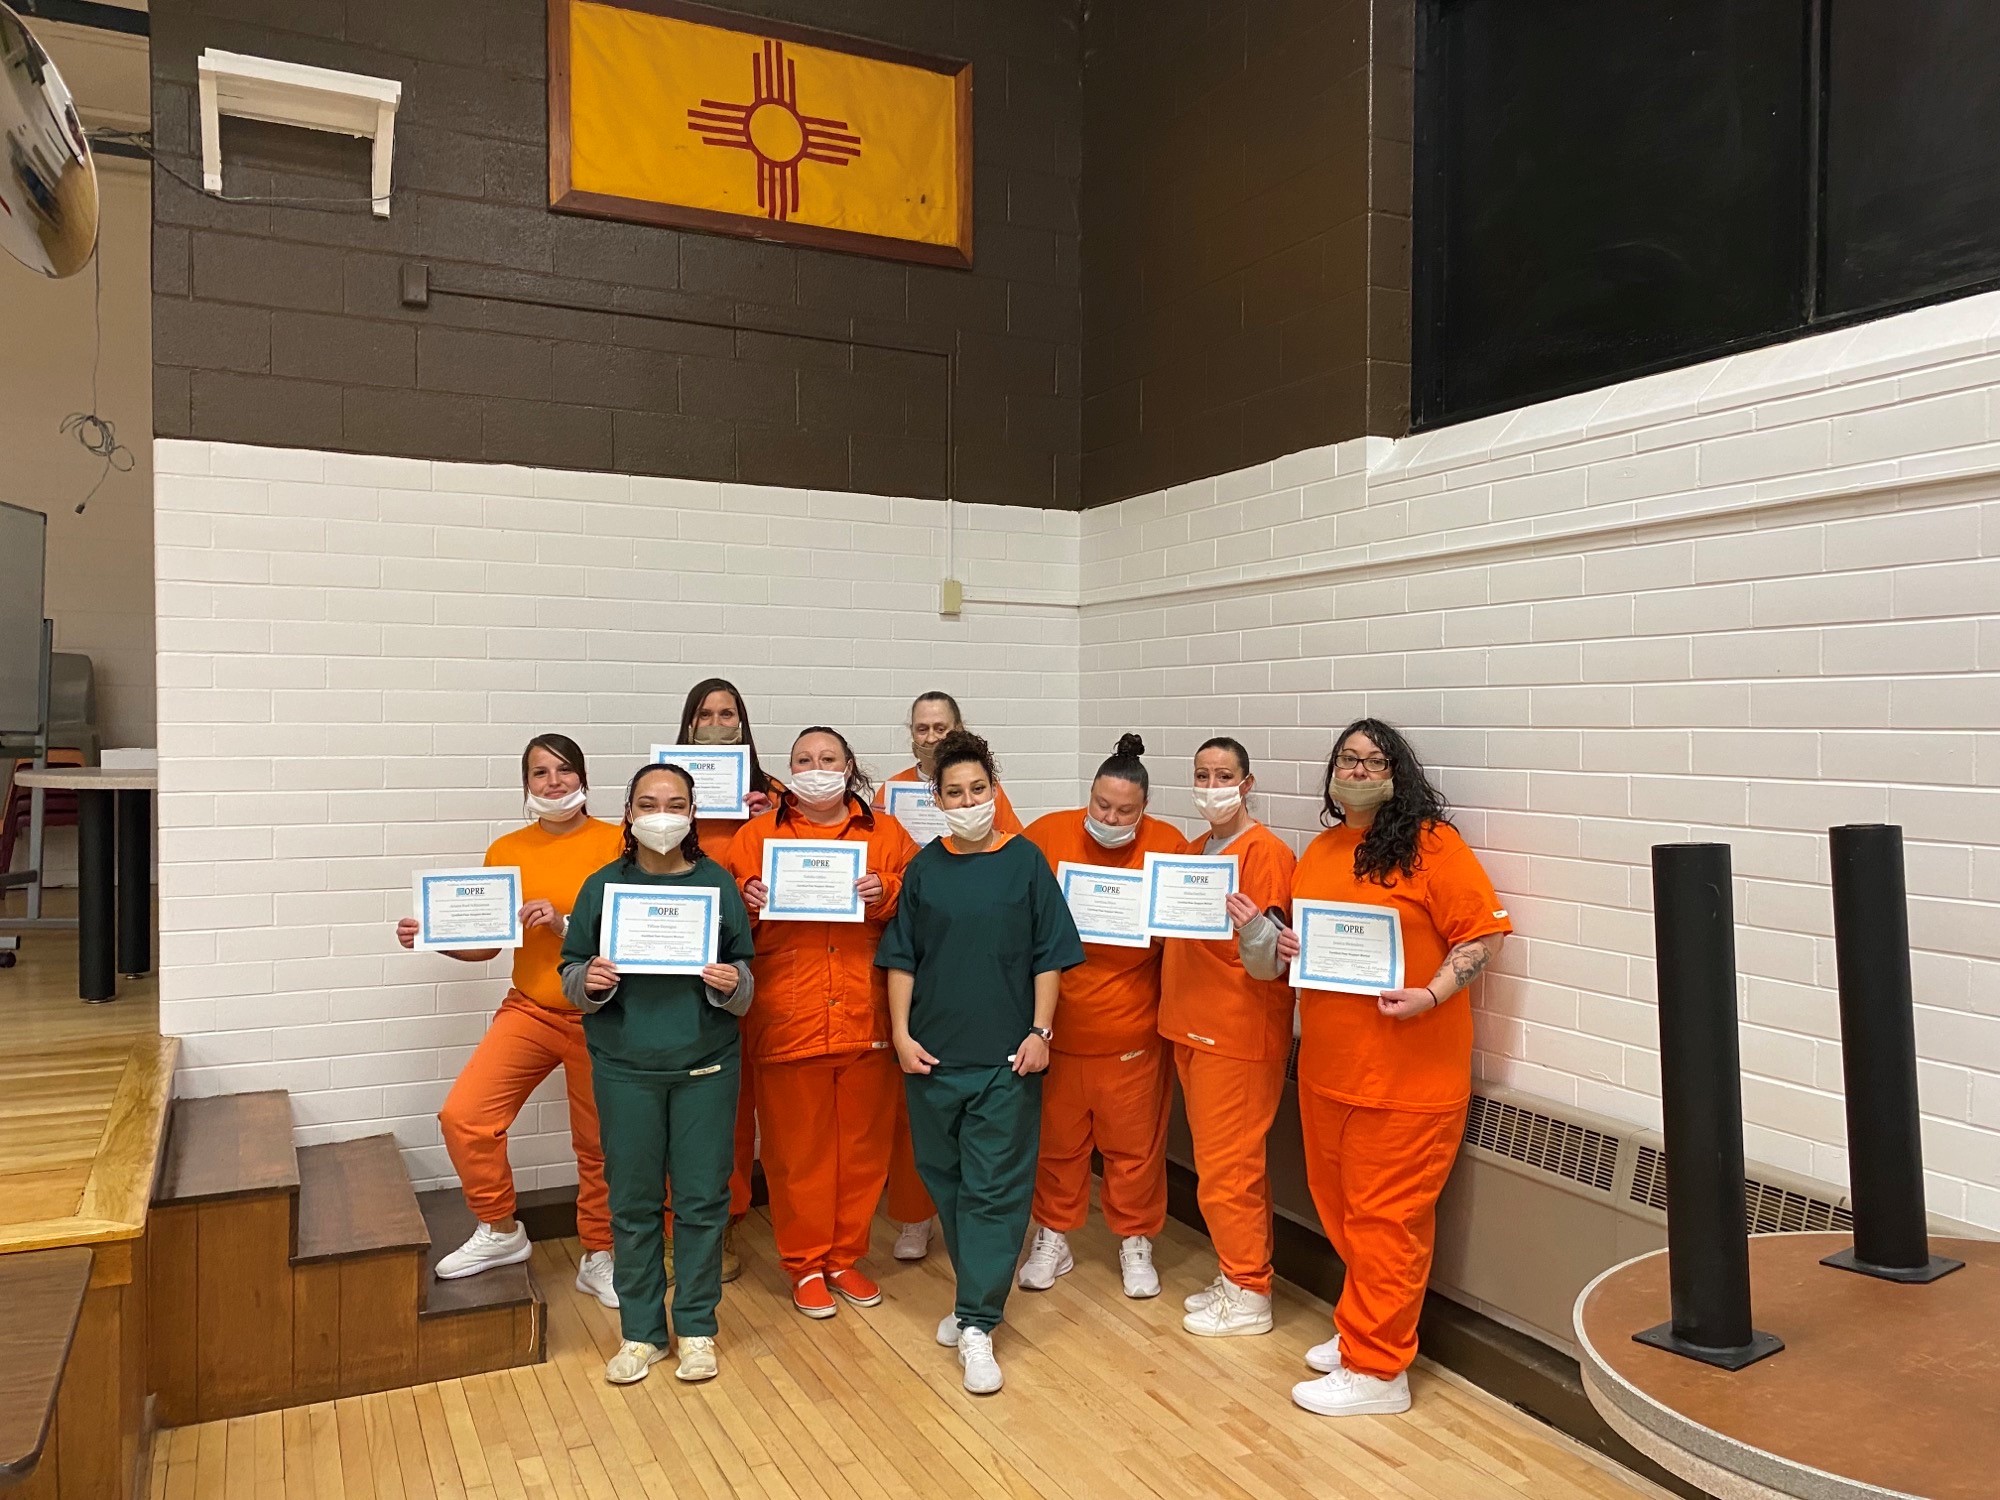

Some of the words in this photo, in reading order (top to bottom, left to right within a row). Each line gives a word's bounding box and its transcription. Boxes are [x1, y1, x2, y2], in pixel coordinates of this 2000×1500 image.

[464, 887, 485, 895] OPRE
[1101, 886, 1120, 894] OPRE
[657, 907, 679, 916] OPRE
[1343, 924, 1364, 934] OPRE
